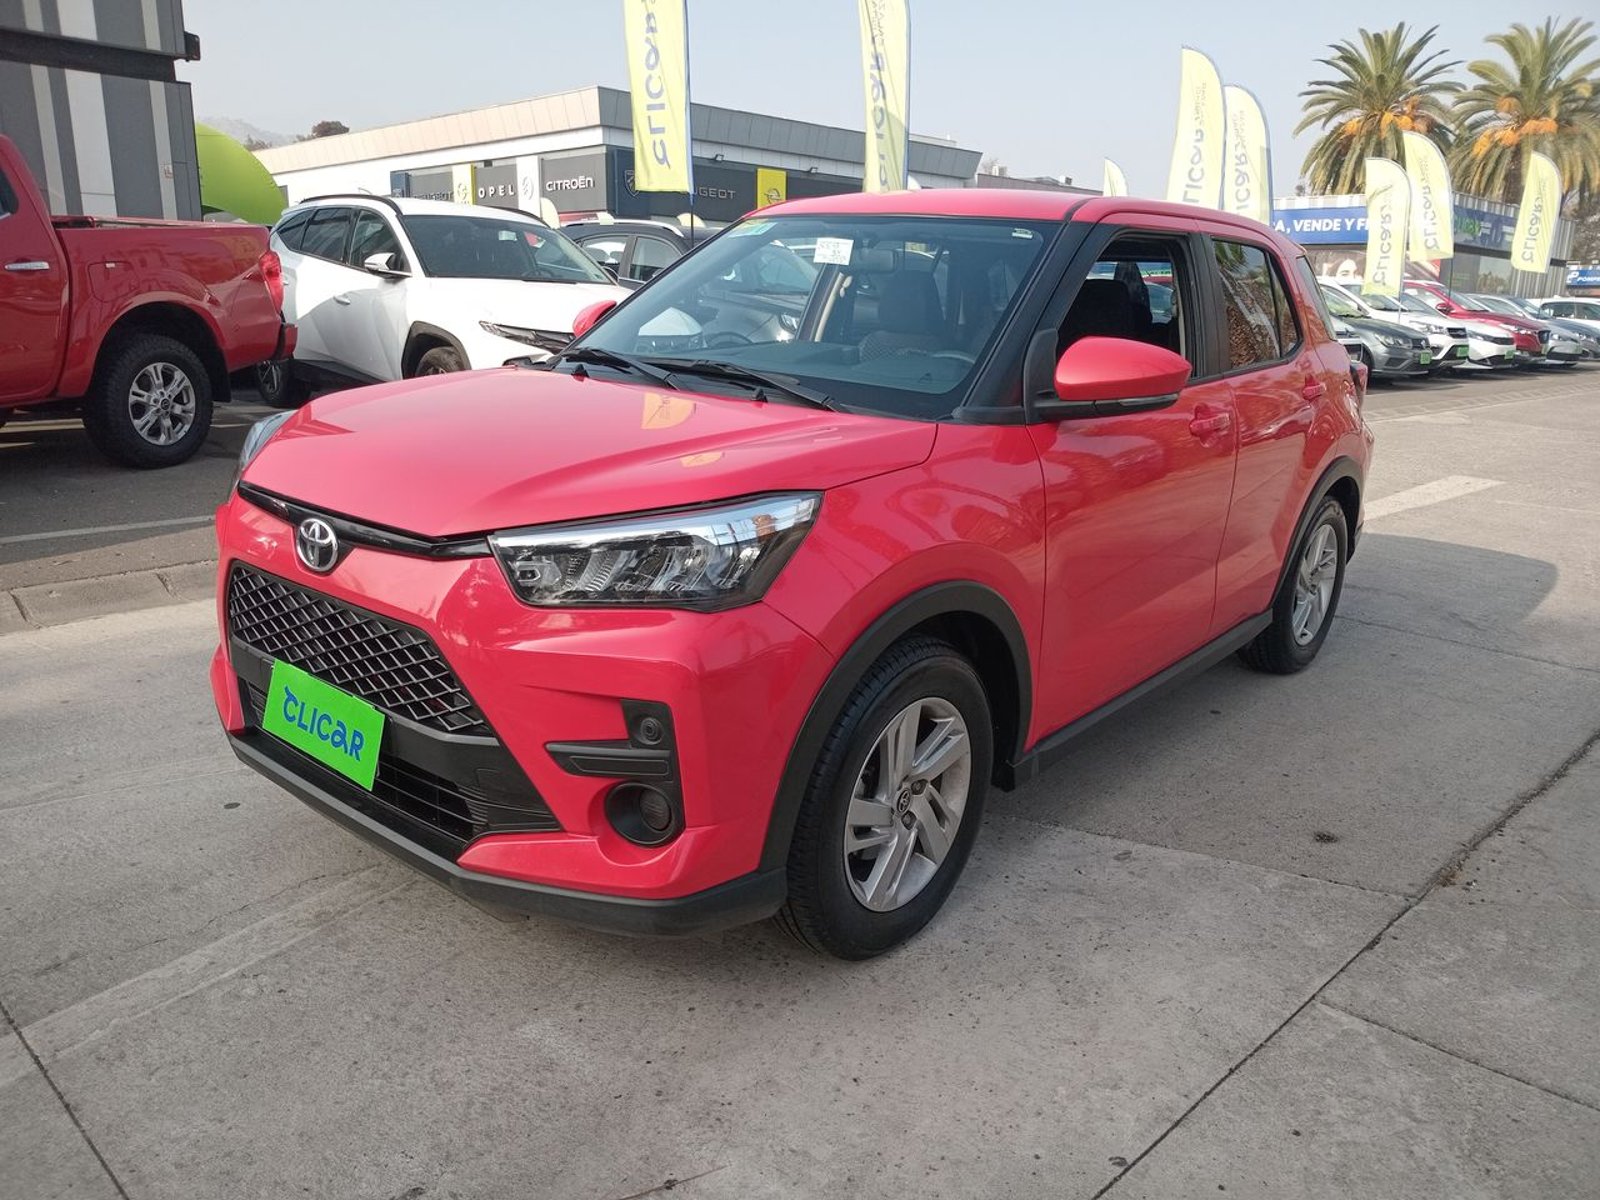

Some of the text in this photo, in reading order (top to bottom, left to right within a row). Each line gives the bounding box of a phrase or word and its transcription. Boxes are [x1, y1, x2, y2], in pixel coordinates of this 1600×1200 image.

[478, 184, 516, 198] OPEL
[1293, 219, 1341, 232] VENDE
[1344, 218, 1355, 231] Y
